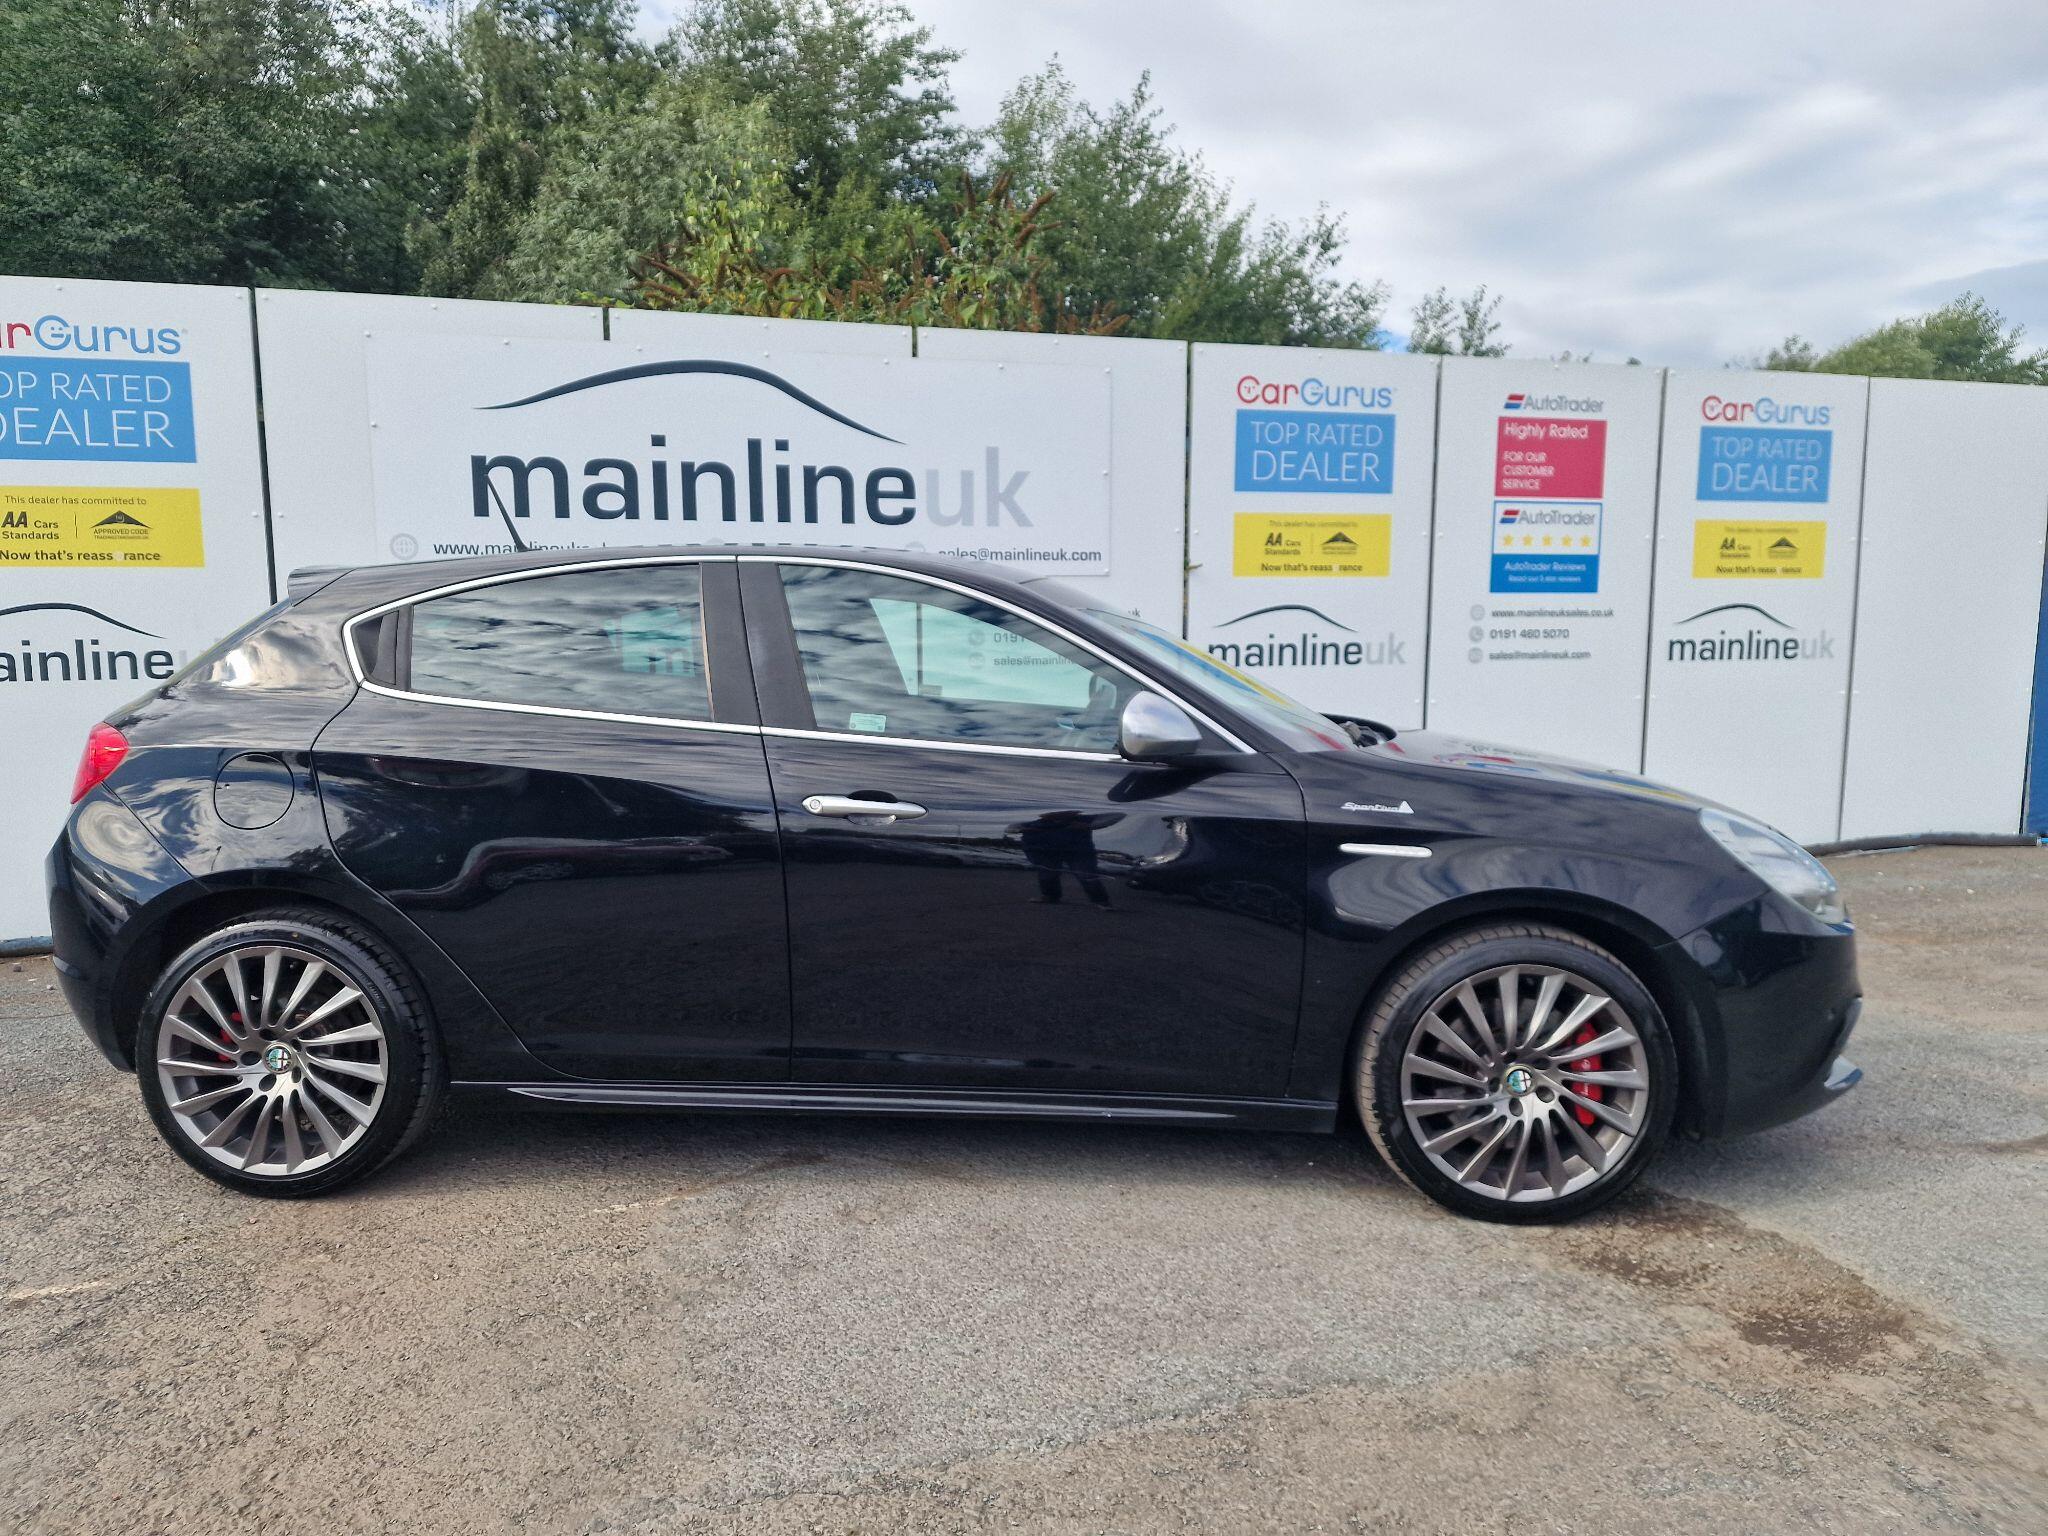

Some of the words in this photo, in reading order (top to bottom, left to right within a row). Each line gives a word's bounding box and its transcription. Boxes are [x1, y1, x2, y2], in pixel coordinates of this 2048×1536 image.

[0, 315, 181, 355] rGurus
[51, 372, 171, 403] RATED
[1237, 375, 1393, 408] CarGurus
[1523, 394, 1604, 413] AutoTrader
[1702, 395, 1830, 425] CarGurus
[1251, 421, 1299, 445] TOP
[1307, 423, 1384, 447] RATED
[1504, 422, 1545, 440] Highly
[1549, 424, 1589, 439] Rated
[1503, 451, 1524, 462] FOR
[1525, 452, 1547, 463] OUR
[1713, 436, 1754, 458] TOP
[1758, 438, 1823, 461] RATED
[1252, 450, 1380, 482] DEALER
[1503, 464, 1555, 476] CUSTOMER
[1502, 478, 1541, 489] SERVICE
[1712, 463, 1819, 493] DEALER
[5, 495, 25, 504] This
[28, 496, 59, 504] dealer
[61, 496, 79, 505] has
[81, 497, 134, 506] committed
[136, 498, 147, 506] to
[1, 511, 28, 529] AA
[33, 520, 59, 529] Cars
[1518, 509, 1596, 526] AutoTrader
[2, 530, 60, 541] Standards
[1264, 532, 1282, 546] AA
[0, 549, 30, 561] Now
[35, 549, 73, 561] that's
[77, 551, 160, 561] reassrance
[1261, 563, 1281, 571] Now
[1310, 564, 1363, 572] reassrance
[1490, 628, 1516, 640] 0191
[1542, 629, 1570, 640] 5070
[0, 639, 190, 683] ainline
